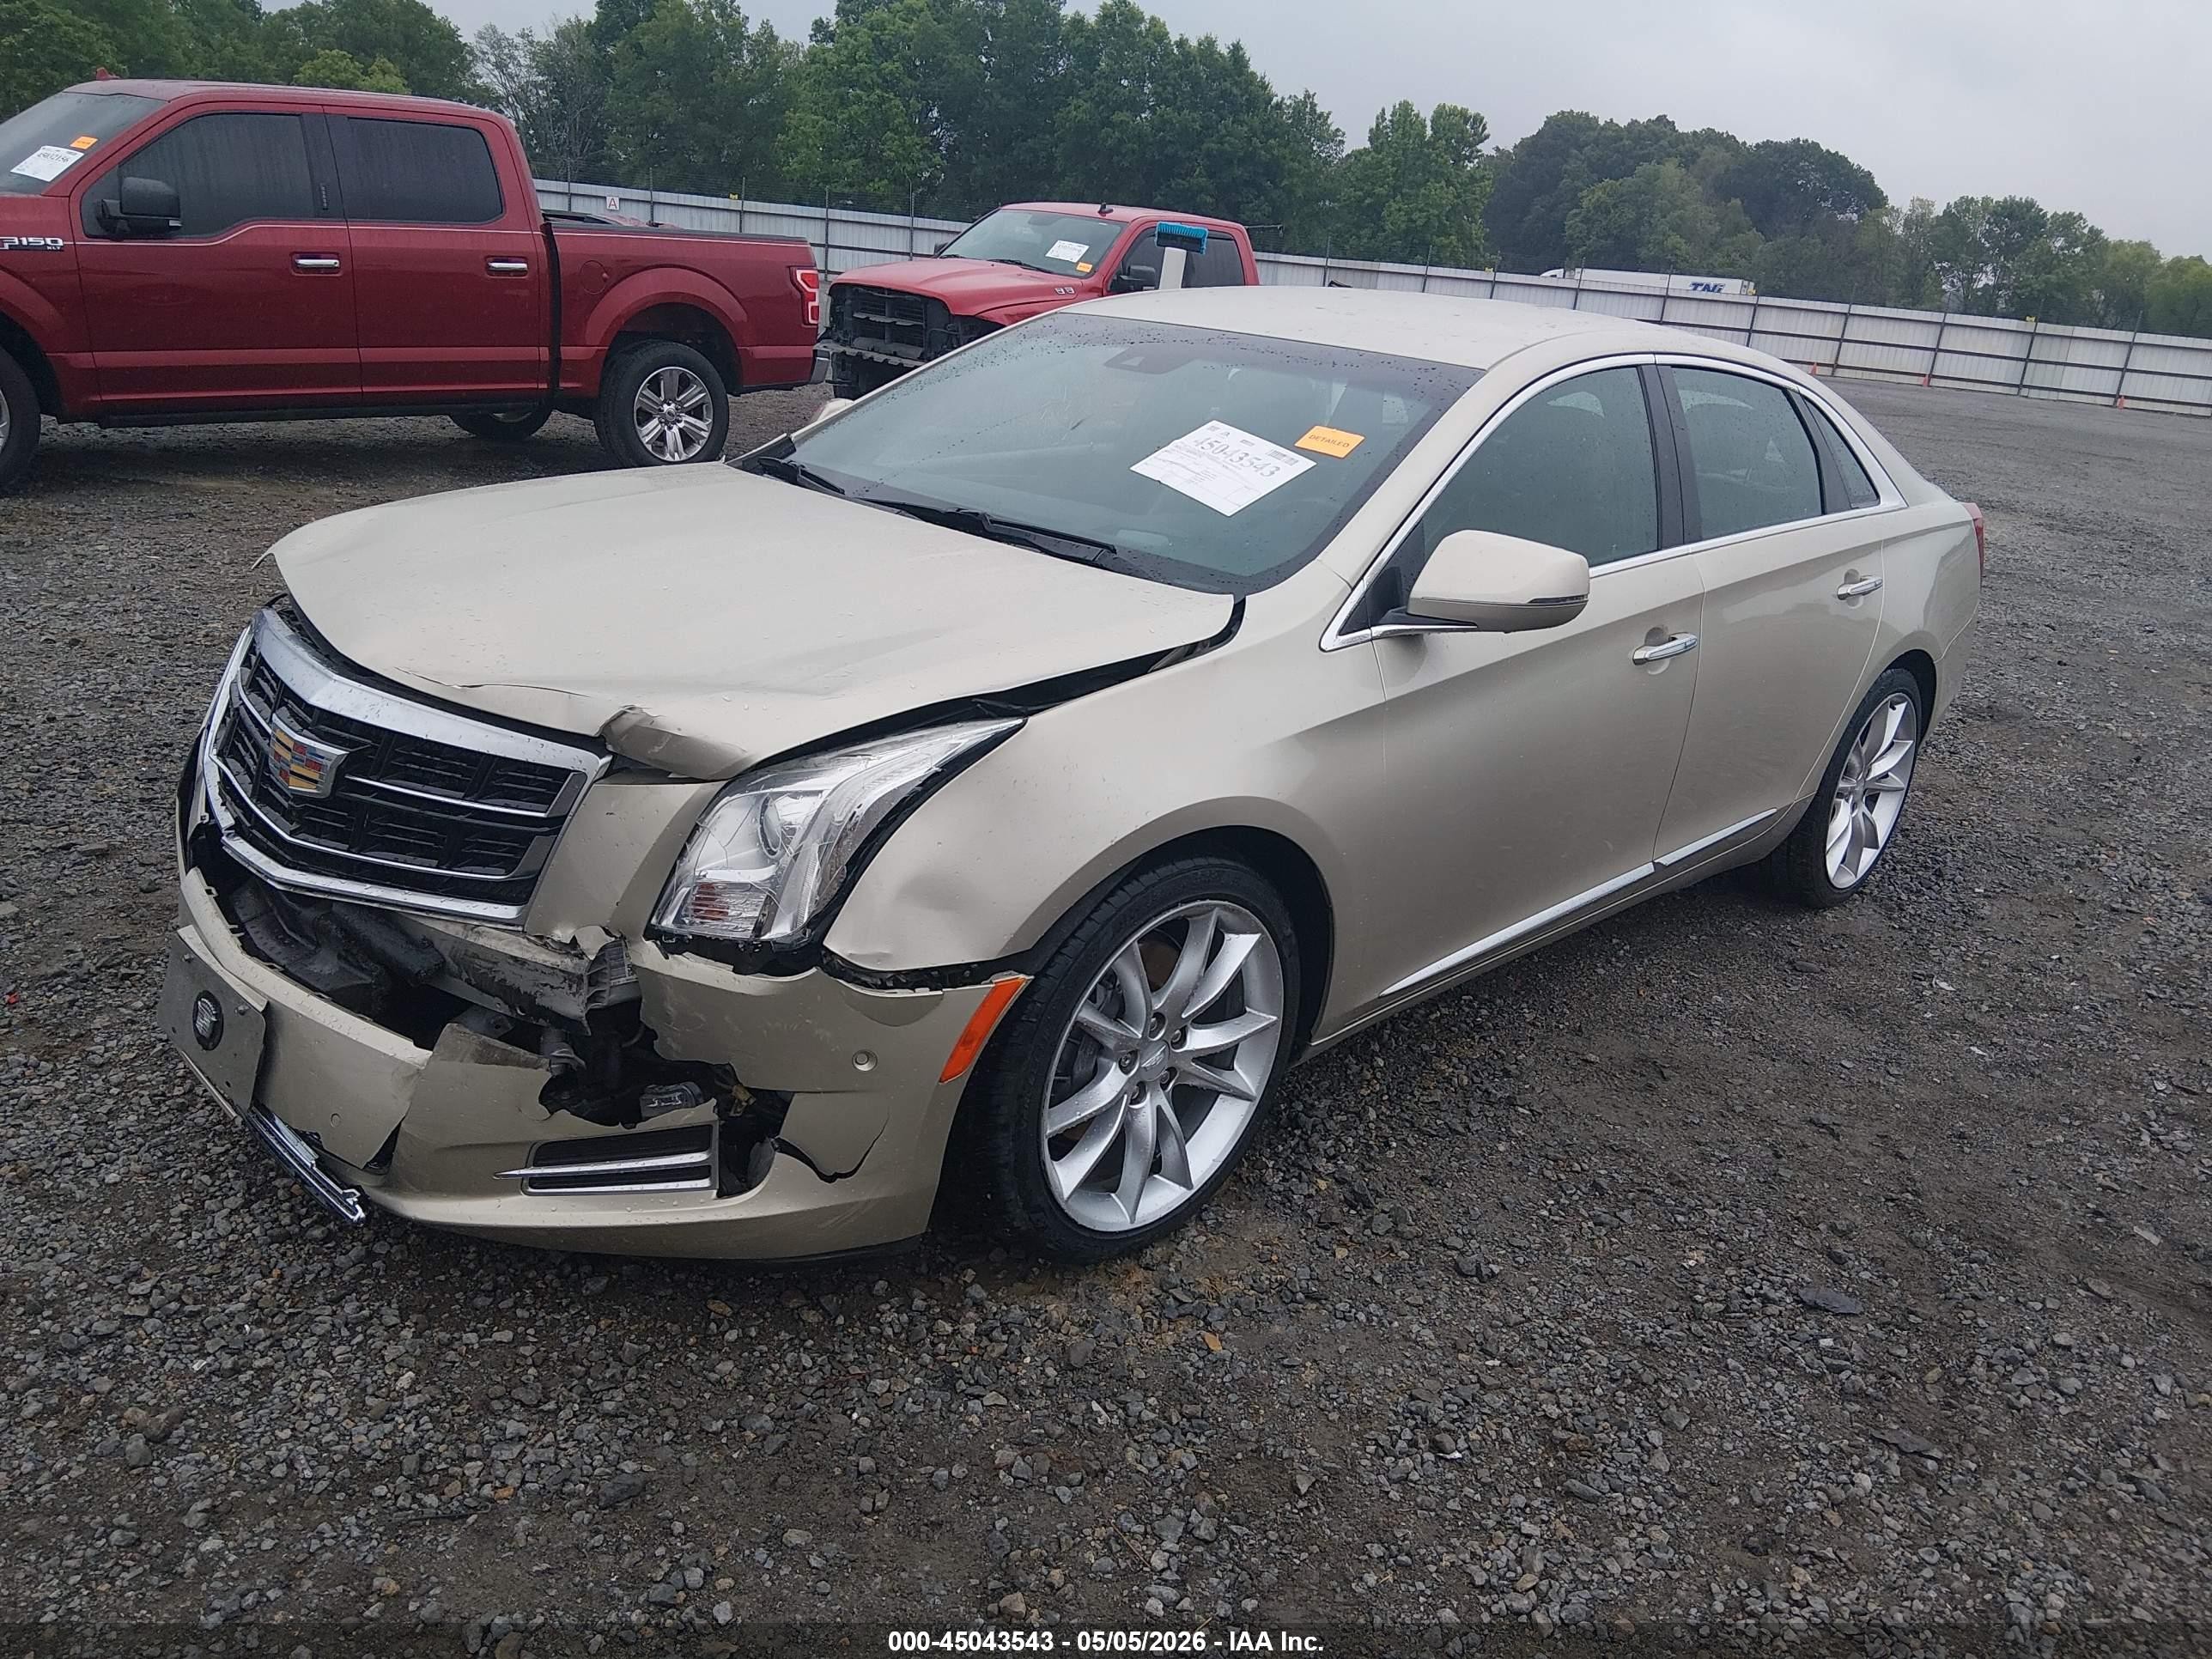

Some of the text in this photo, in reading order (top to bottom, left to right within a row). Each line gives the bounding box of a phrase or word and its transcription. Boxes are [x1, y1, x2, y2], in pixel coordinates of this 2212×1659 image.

[608, 198, 617, 210] A
[1308, 434, 1351, 448] DETAILED
[1194, 437, 1281, 477] 45043543
